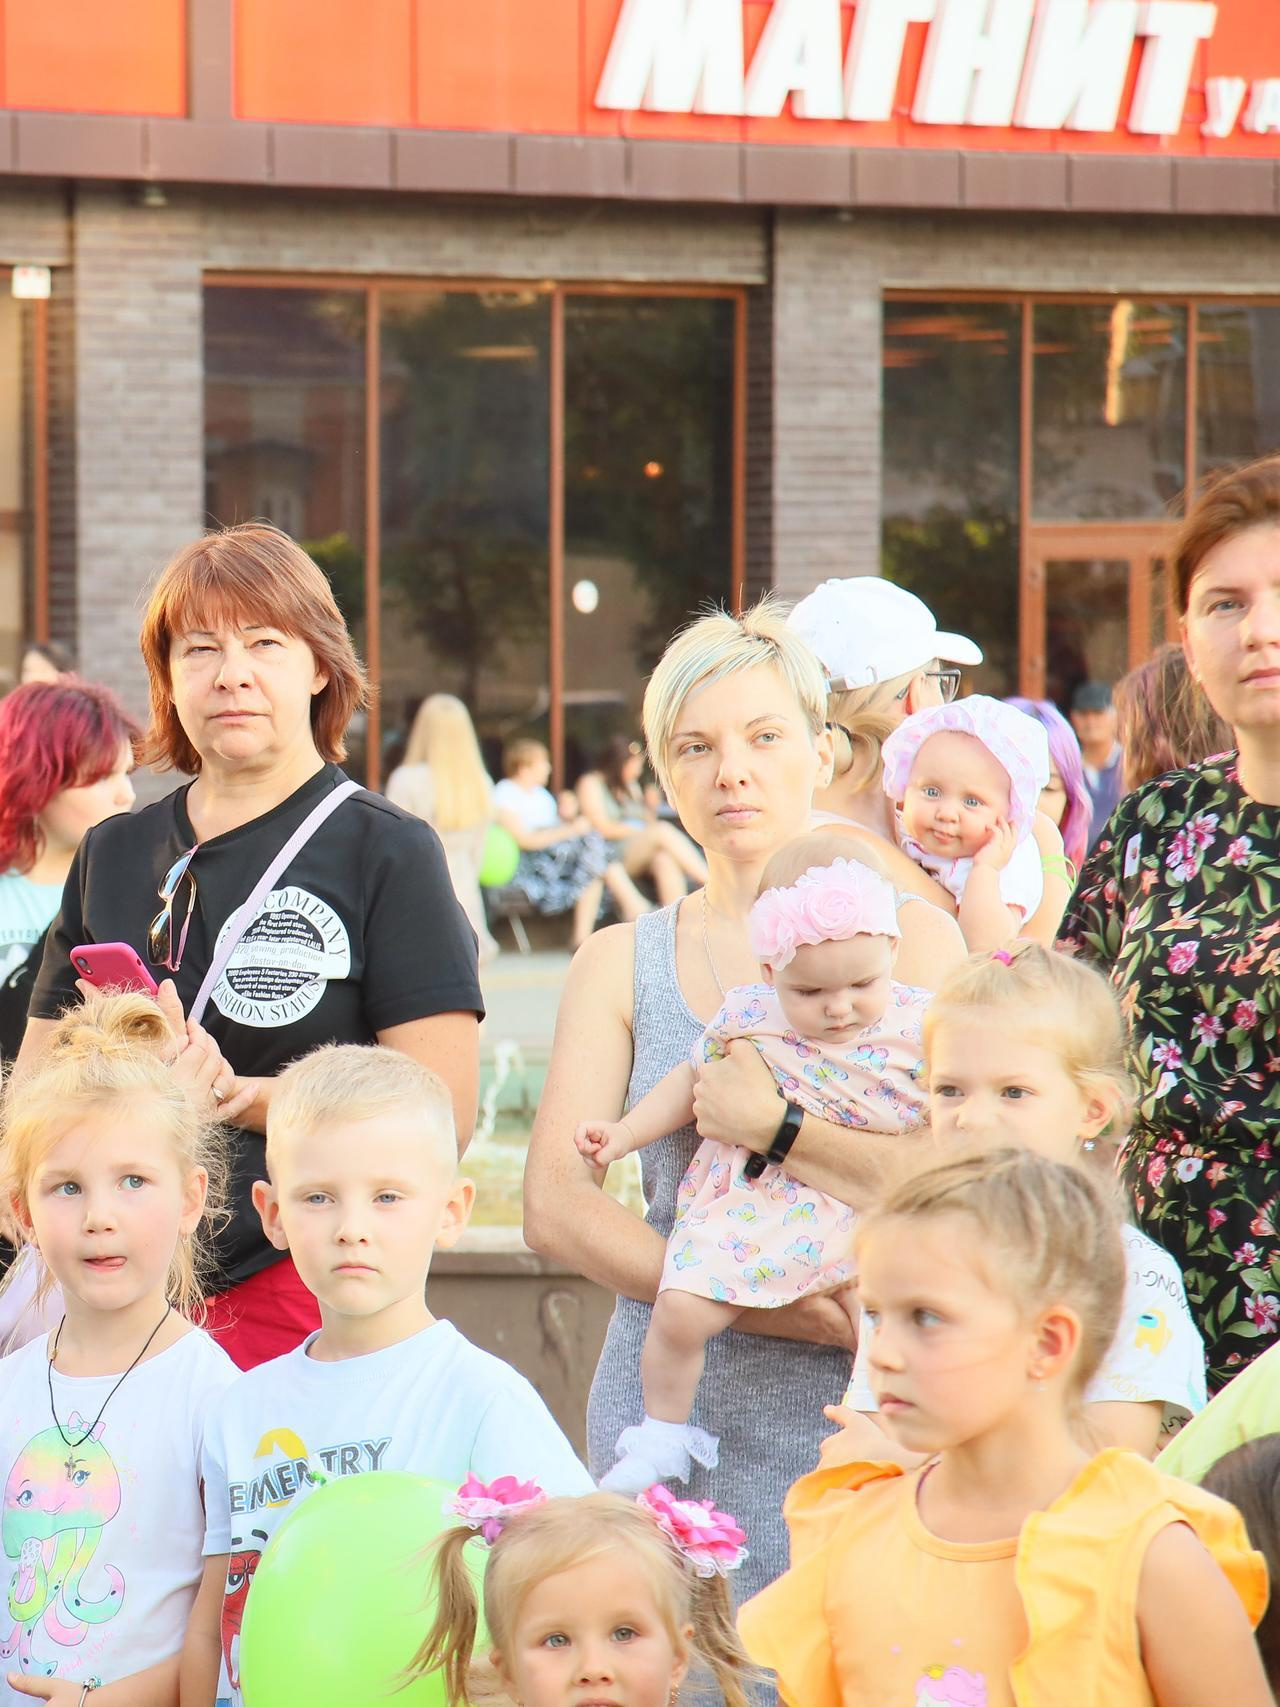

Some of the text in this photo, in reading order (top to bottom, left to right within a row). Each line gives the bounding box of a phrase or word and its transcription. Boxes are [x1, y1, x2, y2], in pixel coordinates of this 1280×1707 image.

[594, 0, 1217, 135] МАГНИТ
[264, 890, 347, 960] COMPANY
[280, 946, 323, 962] production
[213, 981, 320, 1021] FASHION STATUS
[229, 1437, 392, 1514] EMENTRY
